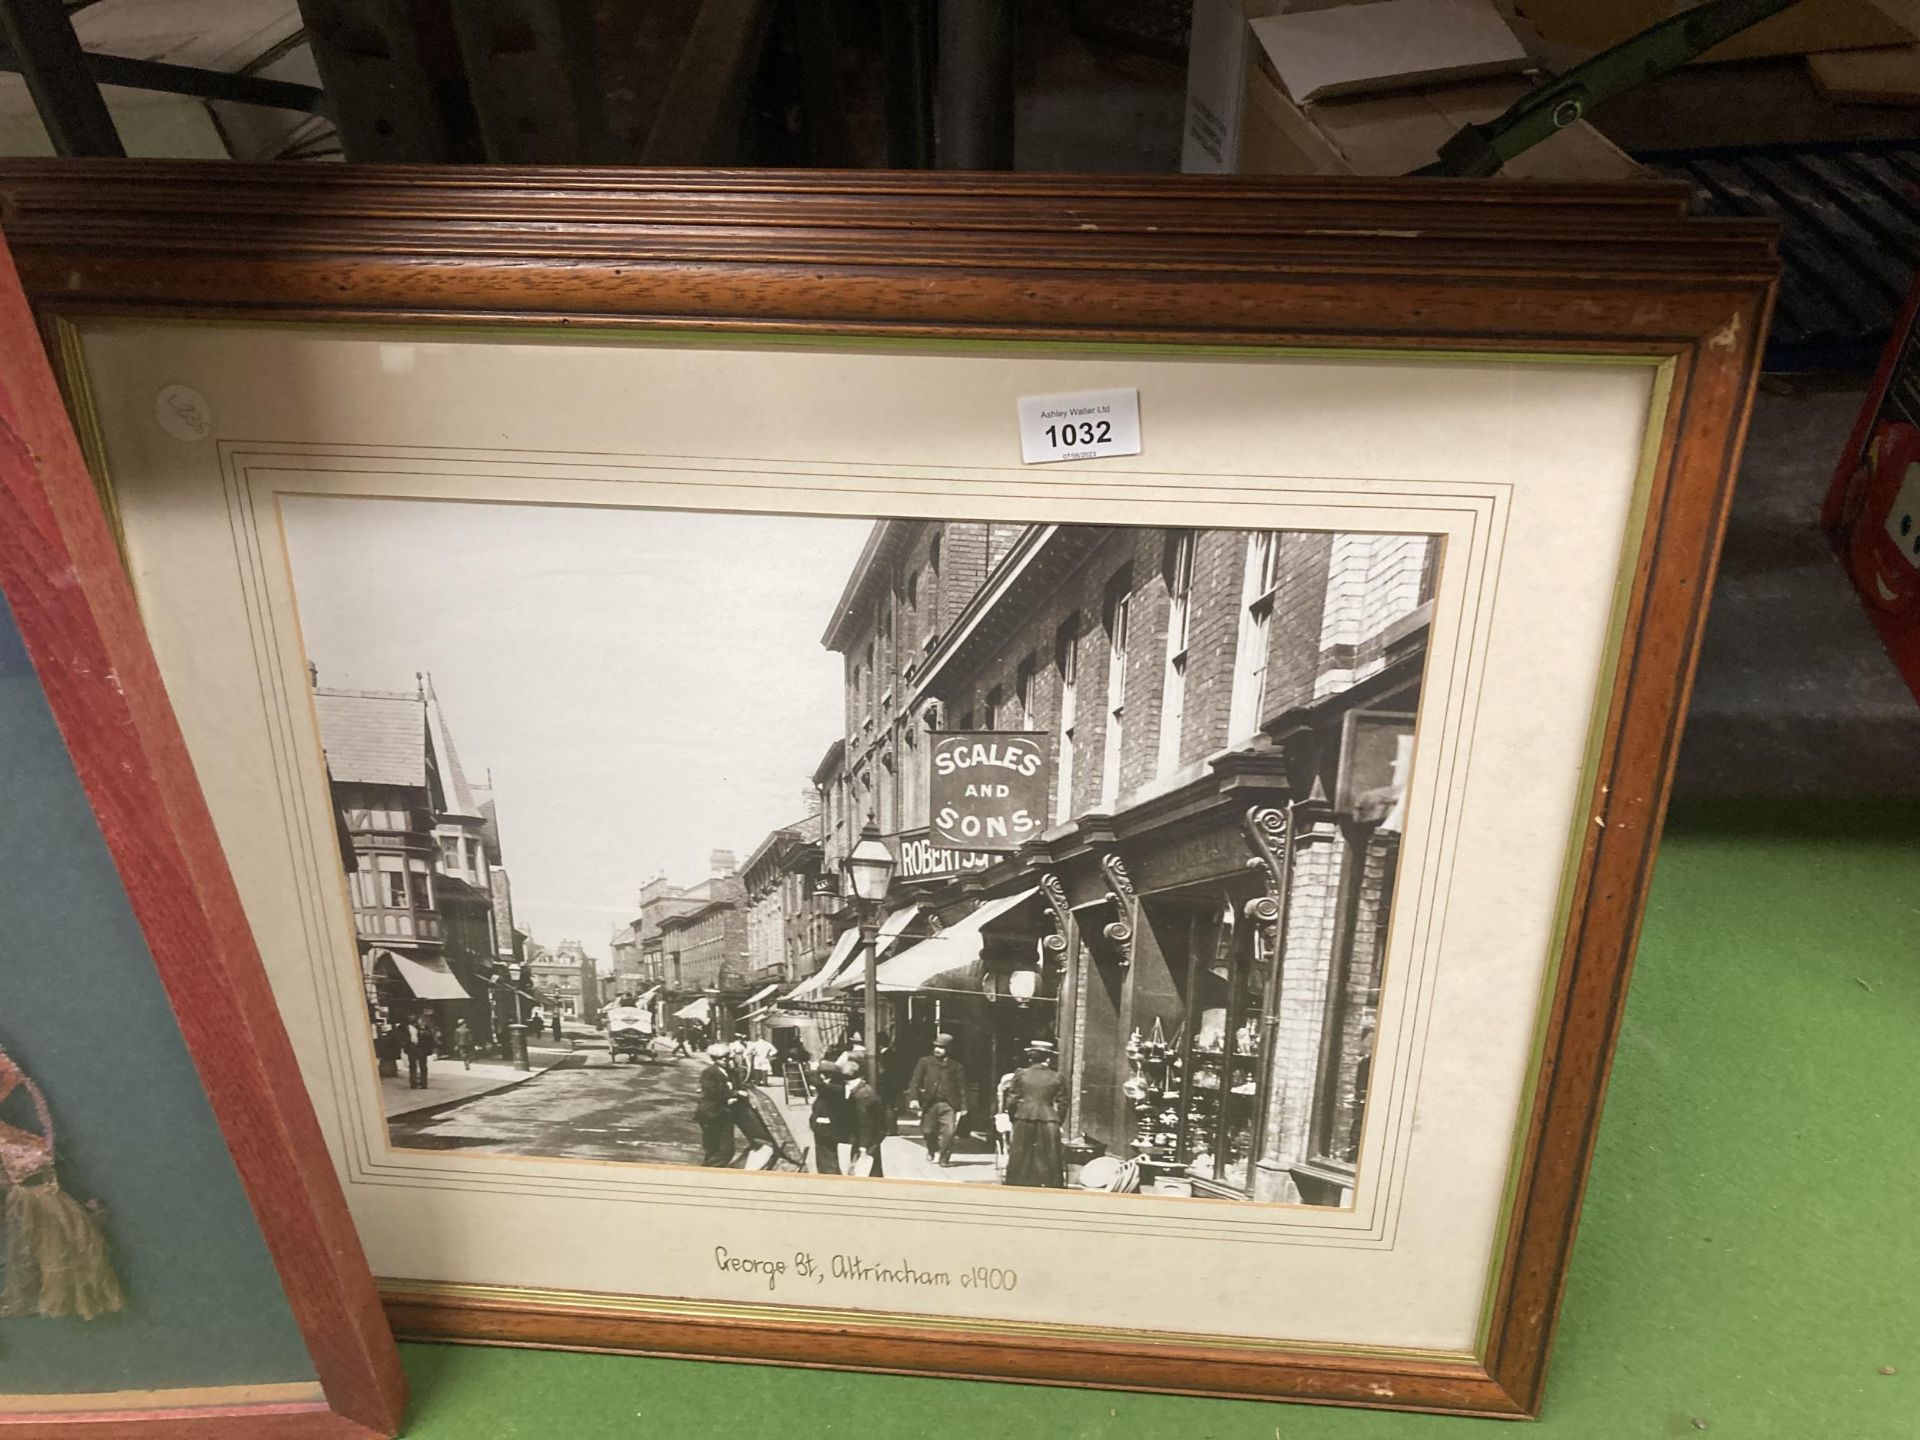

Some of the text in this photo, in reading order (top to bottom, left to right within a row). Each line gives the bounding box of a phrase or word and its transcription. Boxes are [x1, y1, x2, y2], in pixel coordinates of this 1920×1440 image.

[1041, 405, 1110, 419] Ashley Waller Ltd
[1045, 420, 1112, 448] 1032
[935, 743, 1042, 777] SCALES
[965, 784, 1010, 798] AND
[714, 1245, 788, 1291] George
